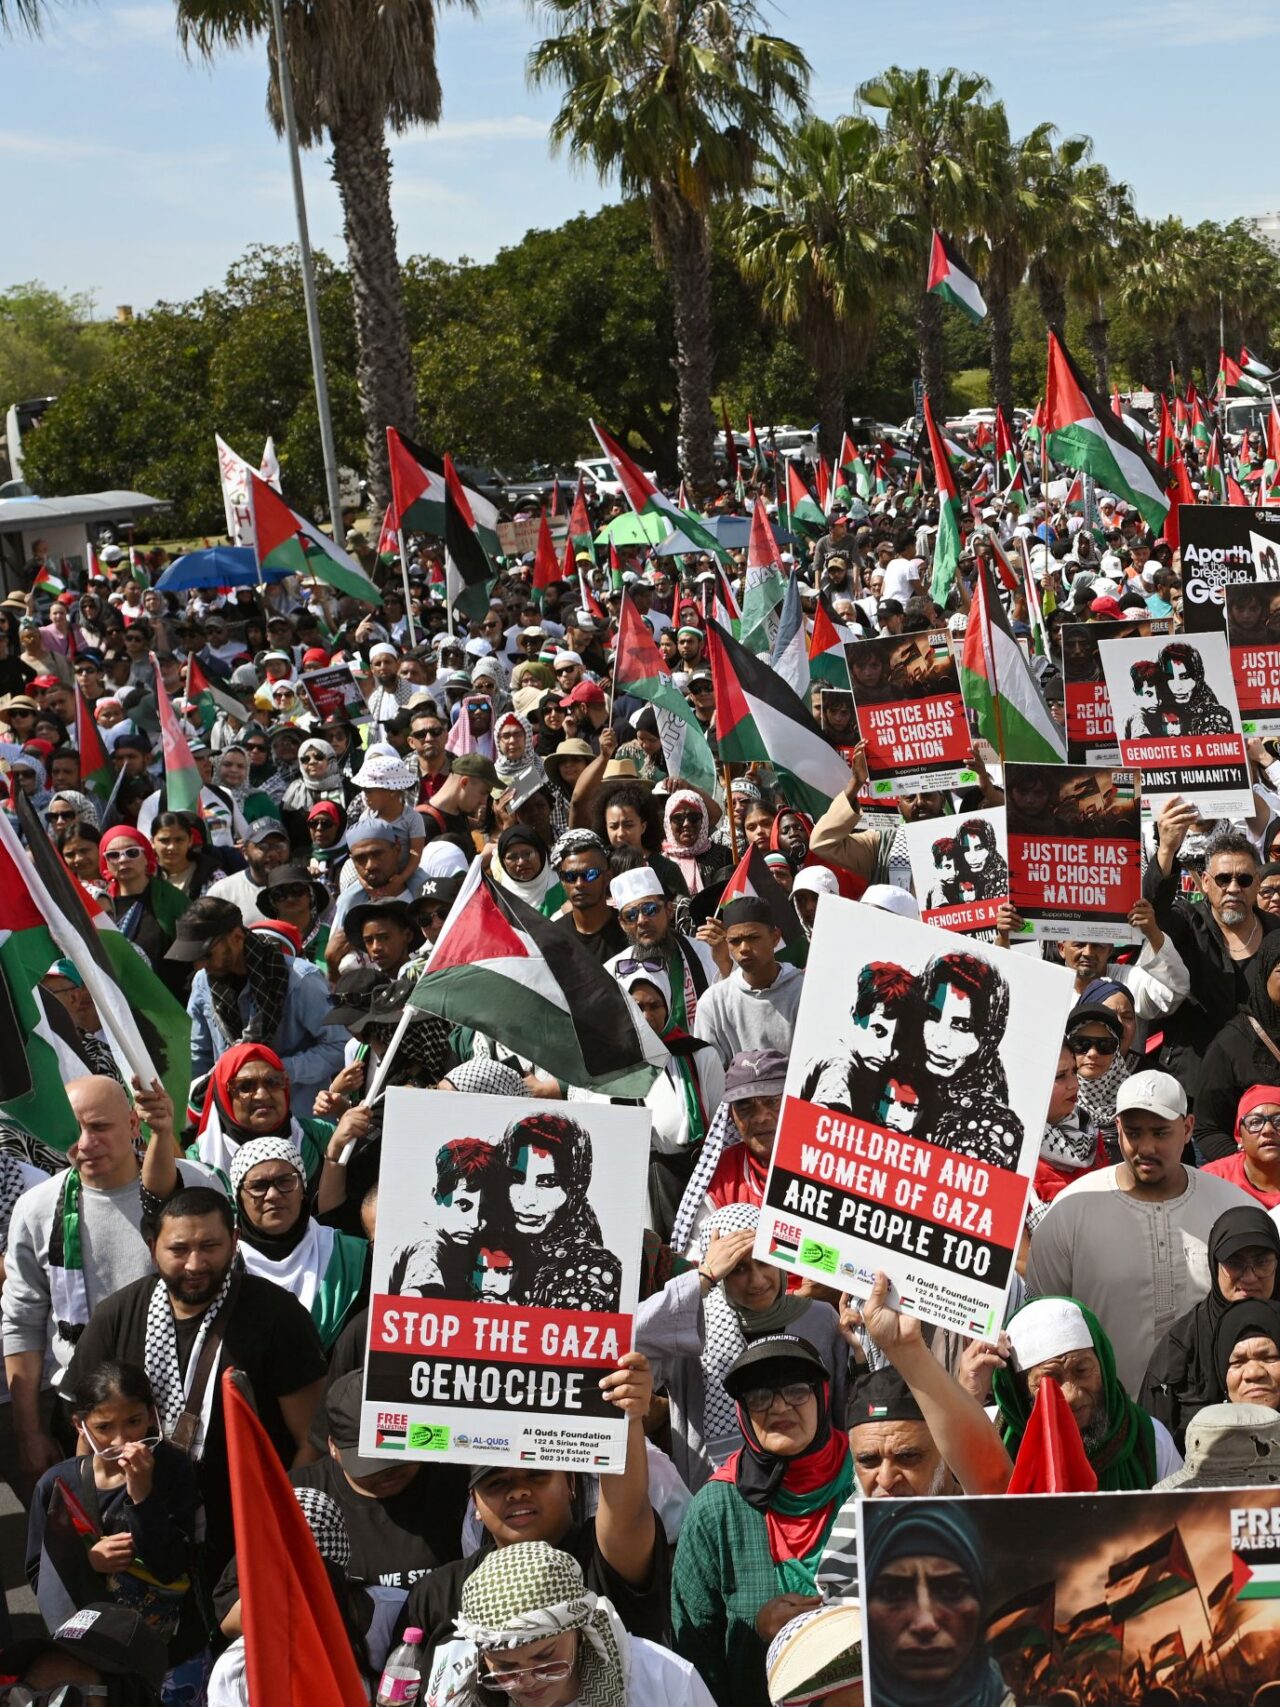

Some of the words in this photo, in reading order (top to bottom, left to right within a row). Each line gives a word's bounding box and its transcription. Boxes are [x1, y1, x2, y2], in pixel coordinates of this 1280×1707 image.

[1150, 621, 1169, 631] FREE
[928, 633, 947, 644] FREE
[1247, 670, 1266, 688] NO
[869, 704, 922, 729] JUSTICE
[925, 700, 955, 721] HAS
[876, 727, 897, 746] NO
[900, 719, 953, 744] CHOSEN
[892, 740, 945, 763] NATION
[1126, 745, 1178, 761] GENOCITE
[1180, 744, 1192, 758] IS
[1195, 743, 1204, 757] A
[1206, 741, 1241, 757] CRIME
[1111, 772, 1134, 783] FREE
[1140, 771, 1177, 786] GAINST
[1180, 768, 1241, 785] HUMANITY!
[1021, 842, 1088, 863] JUSTICE
[1094, 845, 1128, 865] HAS
[1028, 863, 1050, 882] NO
[1056, 864, 1121, 886] CHOSEN
[1043, 884, 1106, 906] NATION
[975, 907, 986, 921] IS
[988, 906, 996, 919] A
[816, 1115, 931, 1178] CHILDREN
[938, 1158, 989, 1197] AND
[800, 1144, 887, 1199] WOMEN
[894, 1178, 927, 1210] OF
[932, 1192, 993, 1237] GAZA
[773, 1220, 802, 1239] FREE
[783, 1179, 833, 1221] ARE
[838, 1197, 933, 1257] PEOPLE
[942, 1233, 991, 1277] TOO
[917, 1277, 939, 1291] Quds
[941, 1286, 990, 1310] Foundation
[936, 1294, 956, 1307] Sirius
[958, 1302, 977, 1314] Road
[944, 1306, 968, 1319] Estate
[381, 1310, 460, 1348] STOP
[472, 1317, 530, 1354] THE
[540, 1323, 619, 1360] GAZA
[409, 1361, 584, 1409] GENOCIDE
[376, 1412, 408, 1426] FREE
[472, 1436, 509, 1446] AL-QUDS
[534, 1428, 558, 1438] Quds
[560, 1430, 612, 1441] Foundation
[556, 1439, 578, 1447] Sirius
[540, 1447, 565, 1455] Surrey
[566, 1448, 591, 1456] Estate
[378, 1572, 402, 1587] WE
